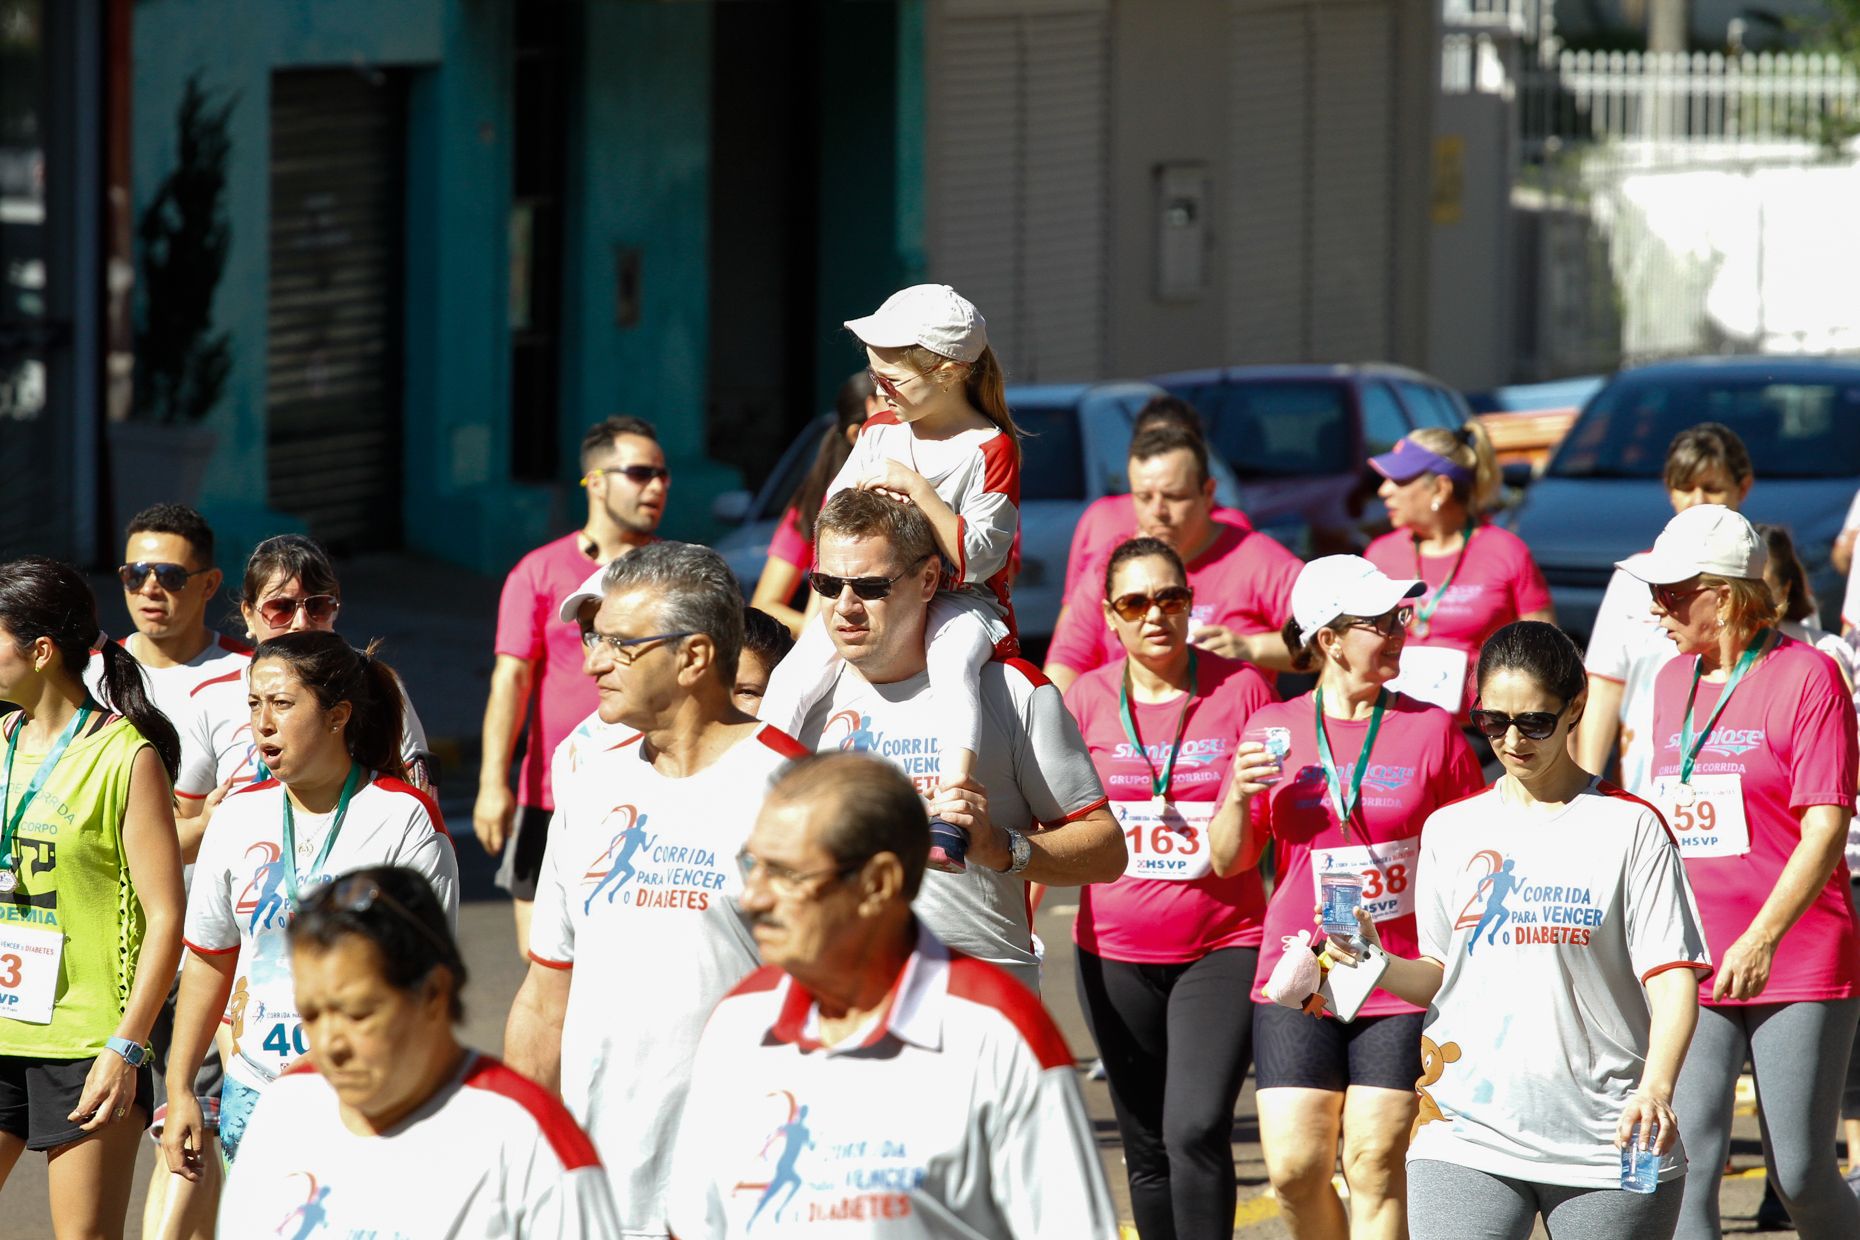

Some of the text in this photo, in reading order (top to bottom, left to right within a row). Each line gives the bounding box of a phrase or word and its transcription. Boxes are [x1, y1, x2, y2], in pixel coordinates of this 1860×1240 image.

[1658, 765, 1685, 775] GRUP
[1703, 763, 1746, 773] CORRIDA
[1109, 775, 1150, 785] GRUPO
[1362, 797, 1403, 807] ORRIDA
[1674, 801, 1716, 831] 59
[20, 821, 58, 835] CORPO
[1126, 825, 1200, 855] 163
[1681, 836, 1718, 845] HSVP
[653, 846, 716, 867] CORRIDA
[1146, 860, 1187, 870] HSVP
[667, 868, 726, 890] VENCER
[636, 888, 709, 911] DIABETES
[1523, 886, 1591, 905] CORRIDA
[1511, 906, 1603, 926] PARA VENCER
[1502, 926, 1591, 946] O DIABETES
[0, 953, 23, 989] 3
